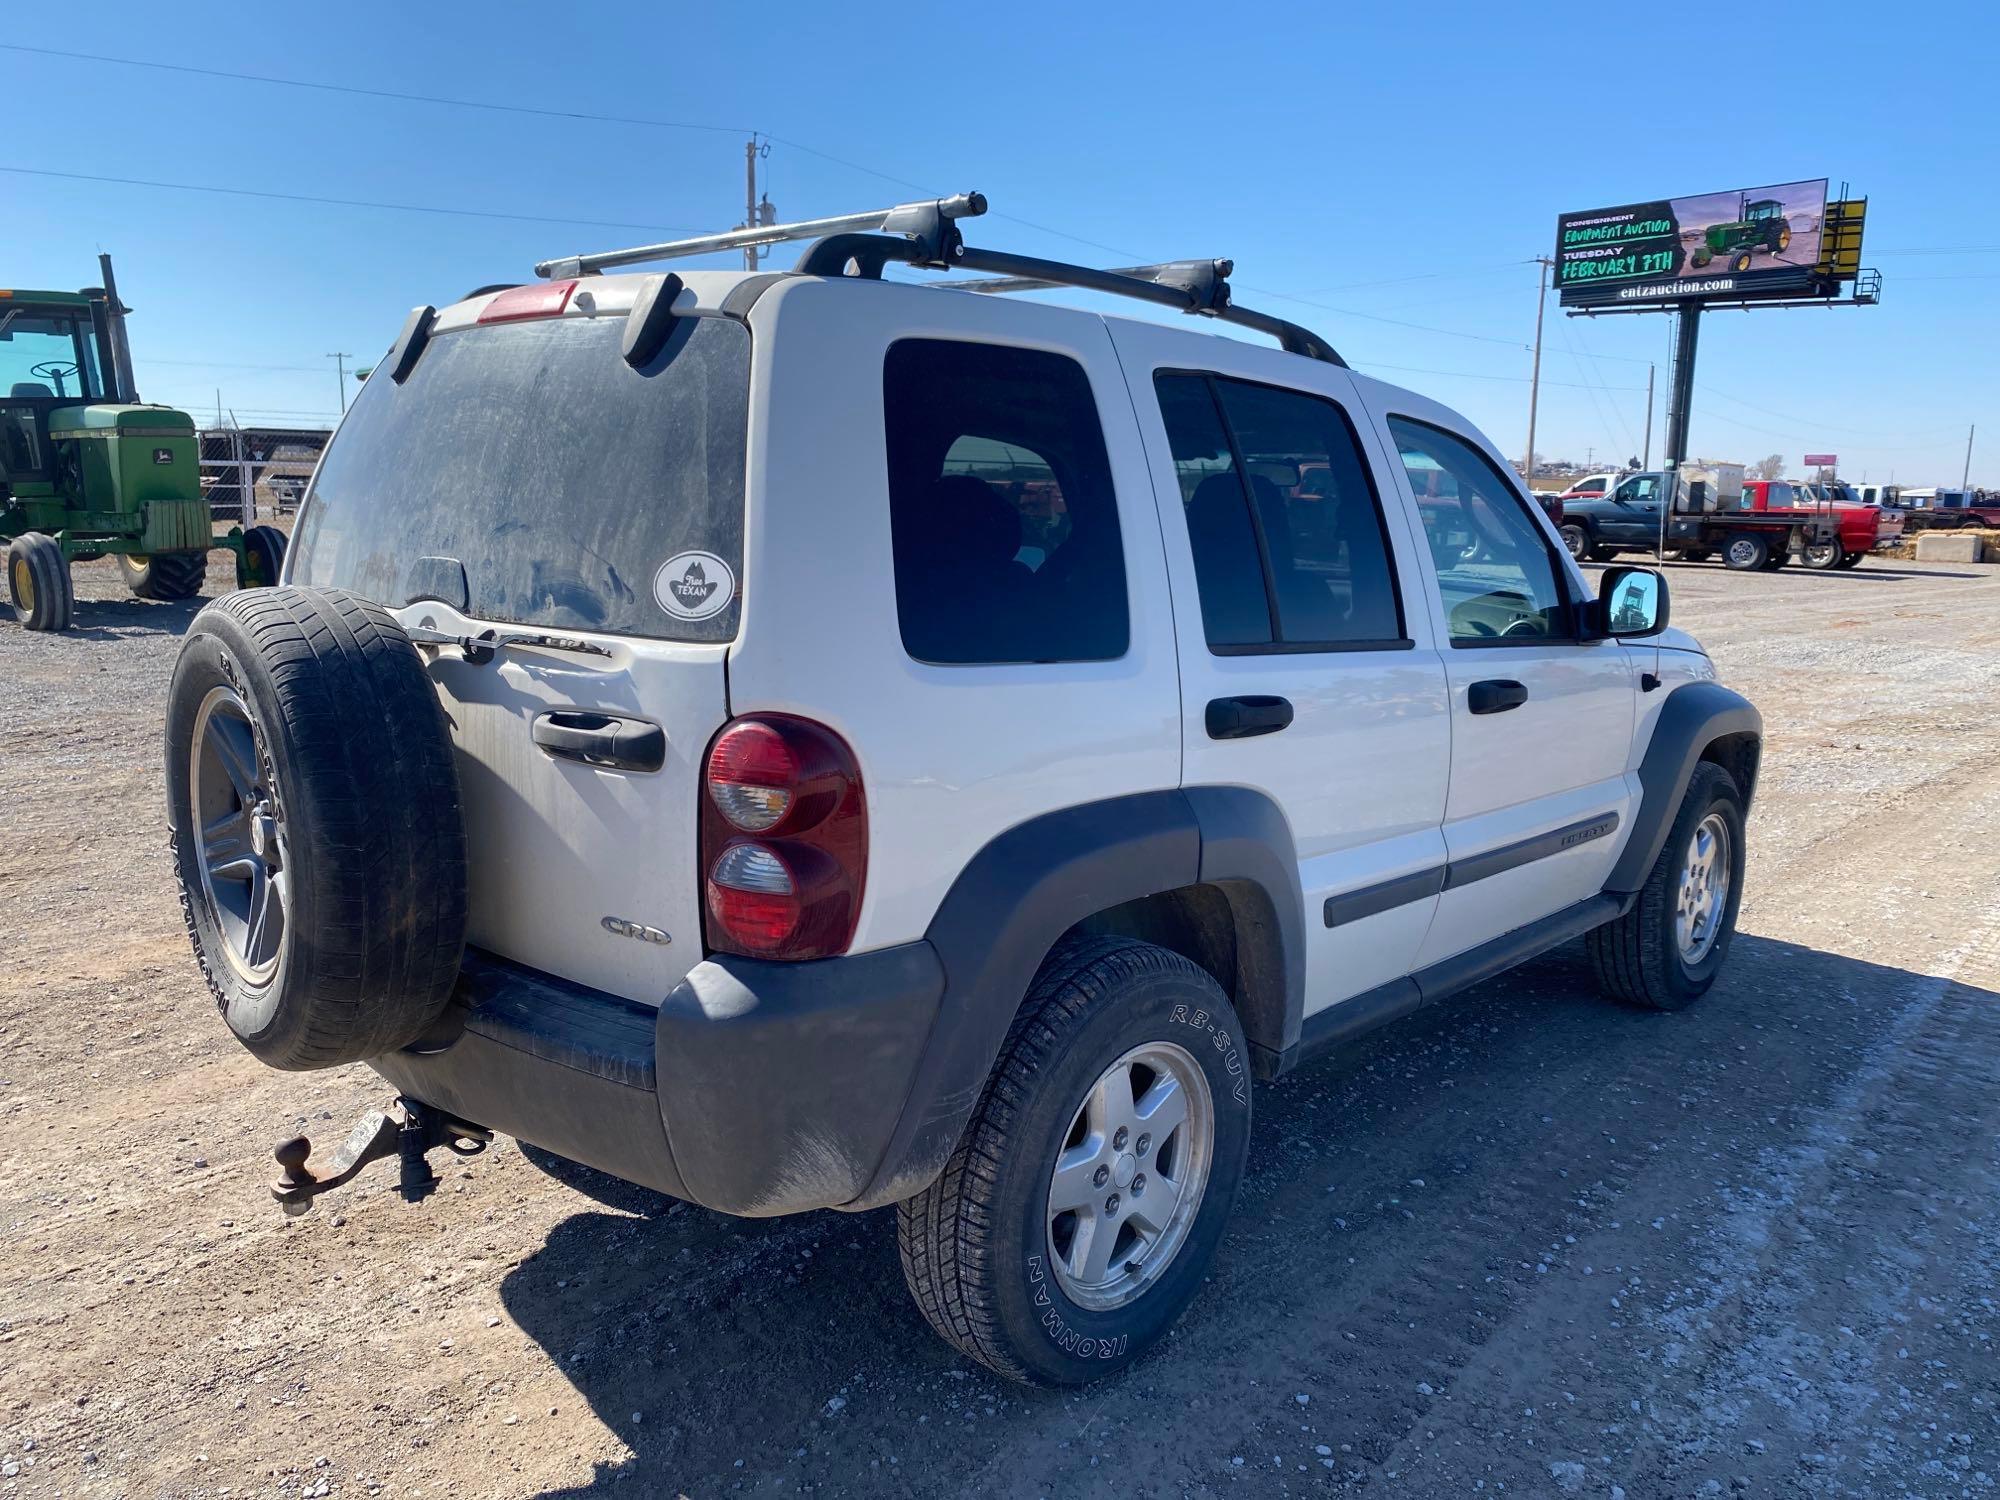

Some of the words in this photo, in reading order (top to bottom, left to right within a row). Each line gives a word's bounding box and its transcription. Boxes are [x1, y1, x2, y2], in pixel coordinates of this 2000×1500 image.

[1564, 224, 1623, 243] EQUIPMENT
[1624, 219, 1671, 236] AUCTION
[1566, 214, 1635, 227] CONSIGNMENT
[1561, 255, 1636, 279] FEBRUARY
[1642, 250, 1673, 271] 7TH
[1563, 247, 1624, 260] TUESDAY
[1620, 278, 1733, 298] entzauction.com
[677, 585, 707, 597] TEXAN
[600, 916, 672, 944] CRD
[1168, 1004, 1248, 1107] RB-SUV
[1027, 1255, 1129, 1360] IRONMAN
